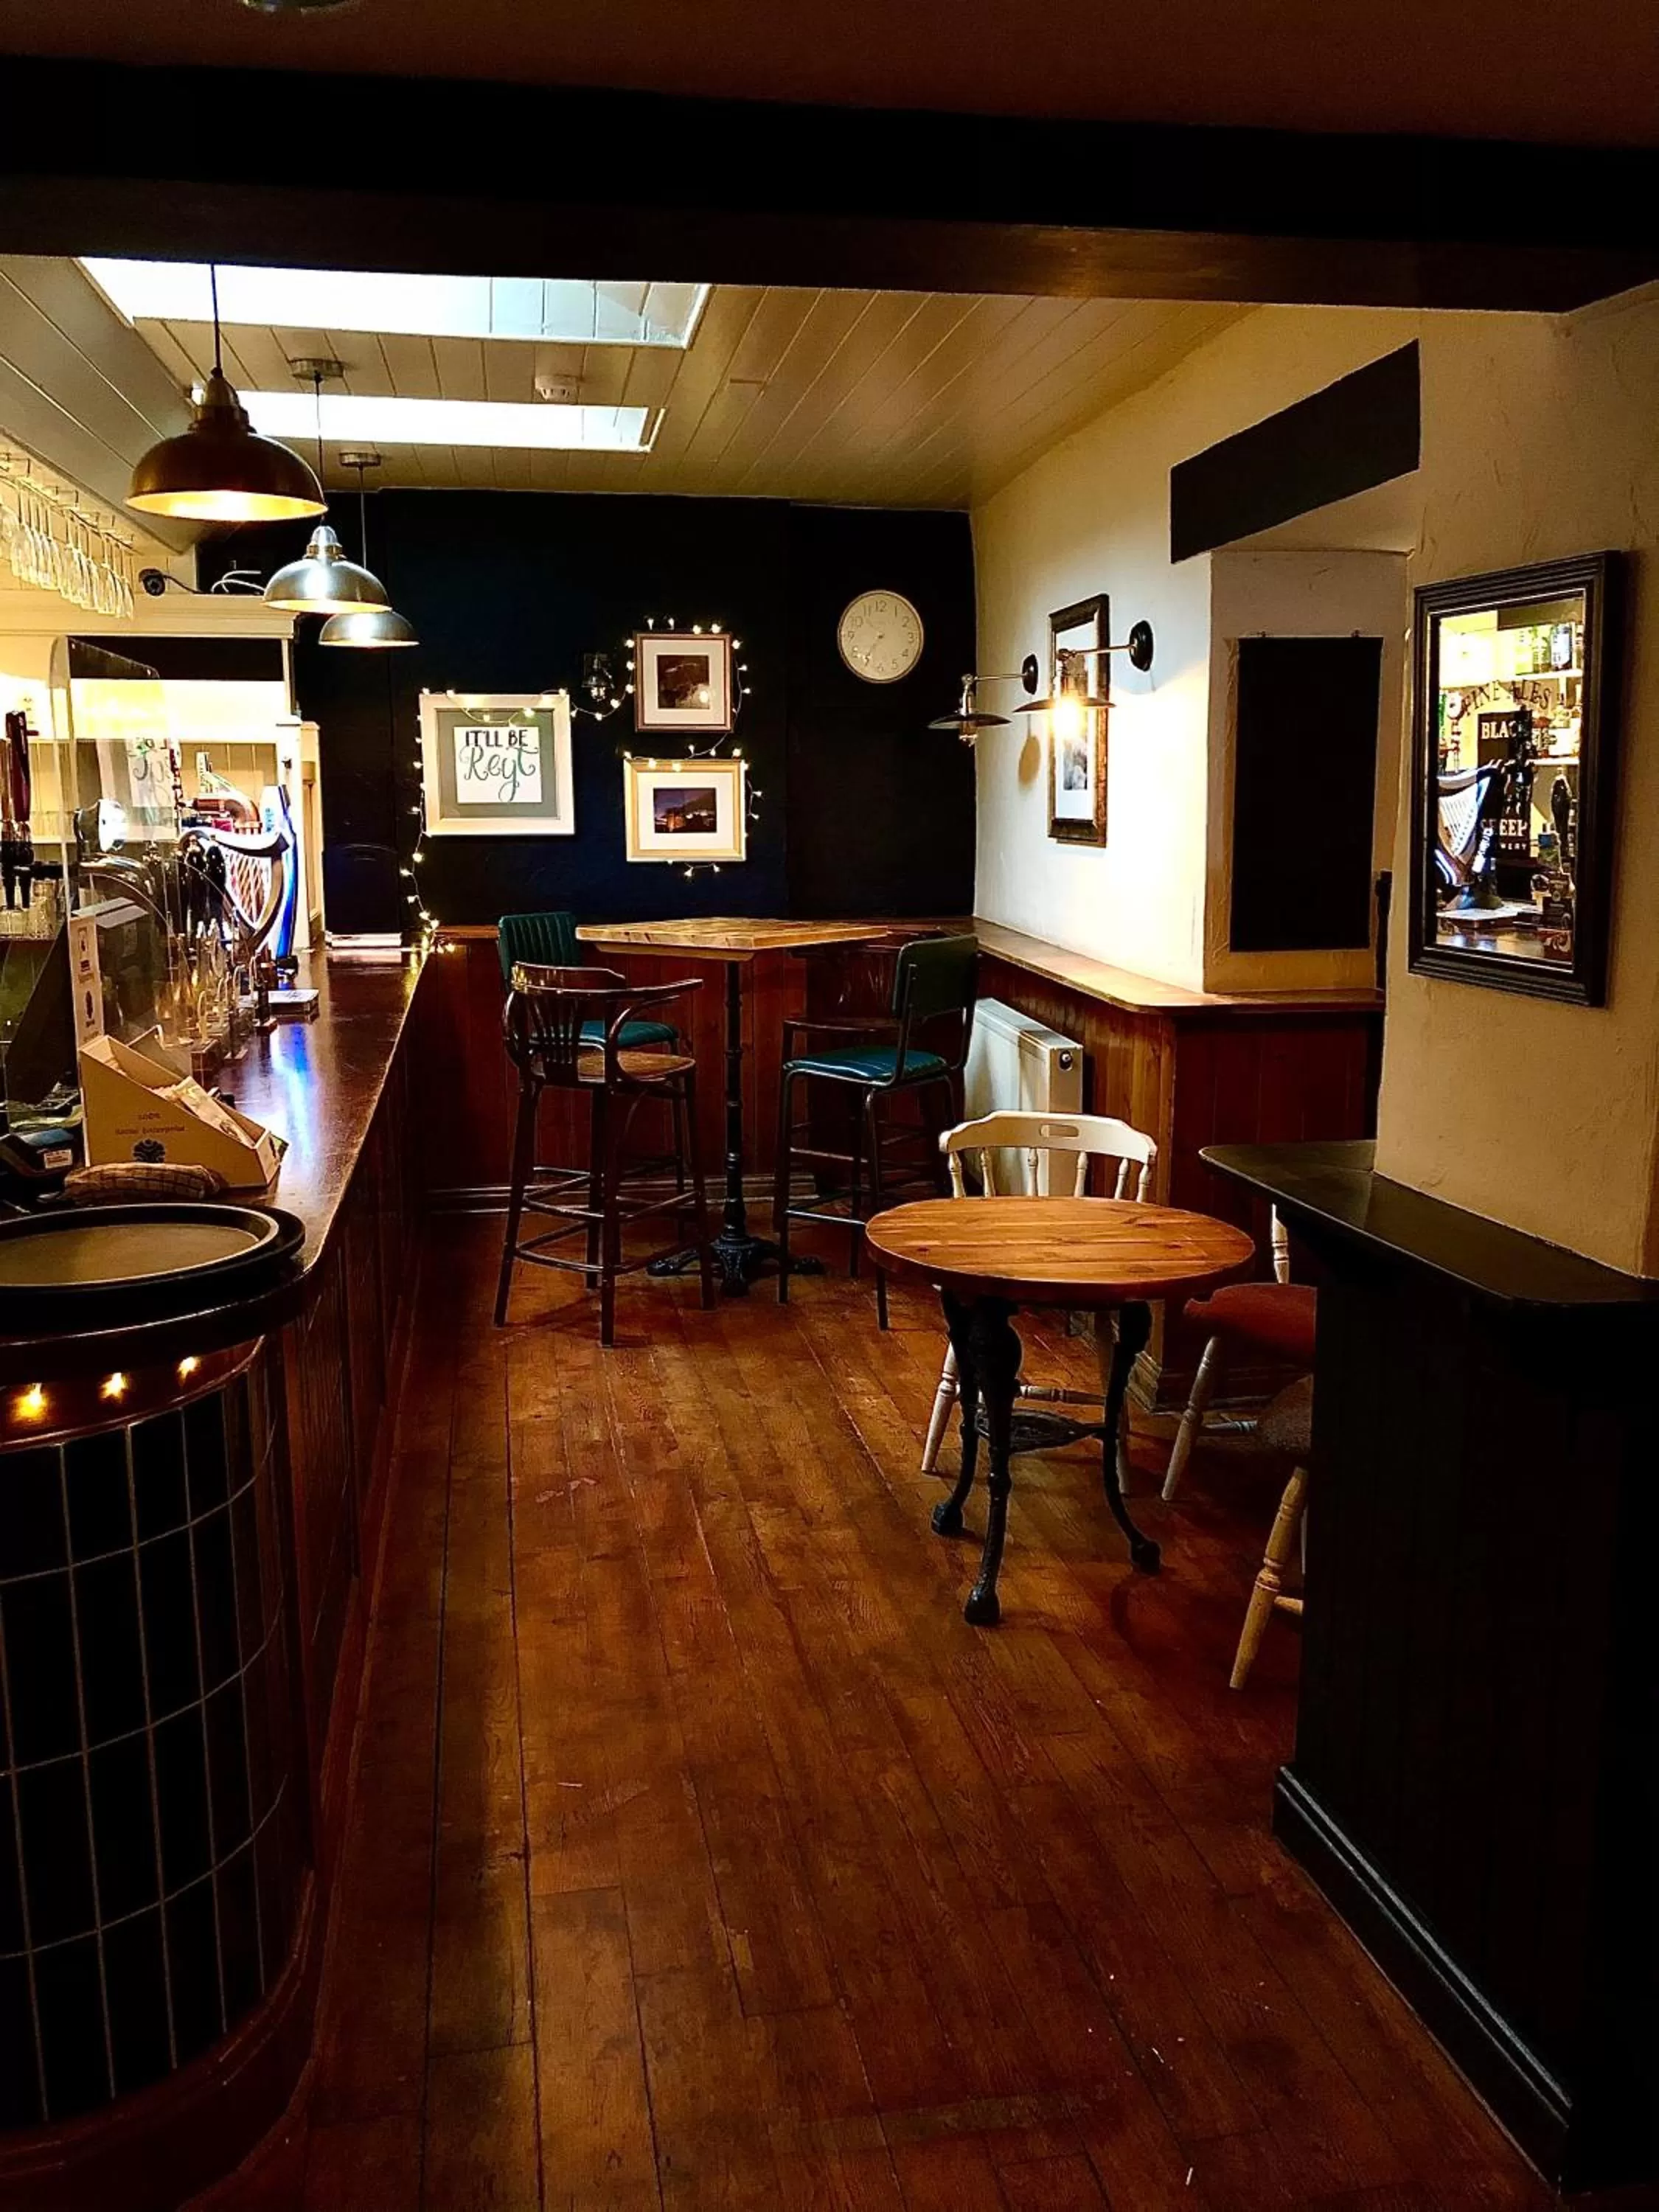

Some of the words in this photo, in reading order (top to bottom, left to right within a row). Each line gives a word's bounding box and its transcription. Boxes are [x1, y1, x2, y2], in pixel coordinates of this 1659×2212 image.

[874, 600, 886, 613] 12
[465, 730, 503, 747] IT'LL
[508, 729, 529, 747] BE
[1481, 720, 1523, 740] BLAC
[459, 743, 539, 803] Reyt
